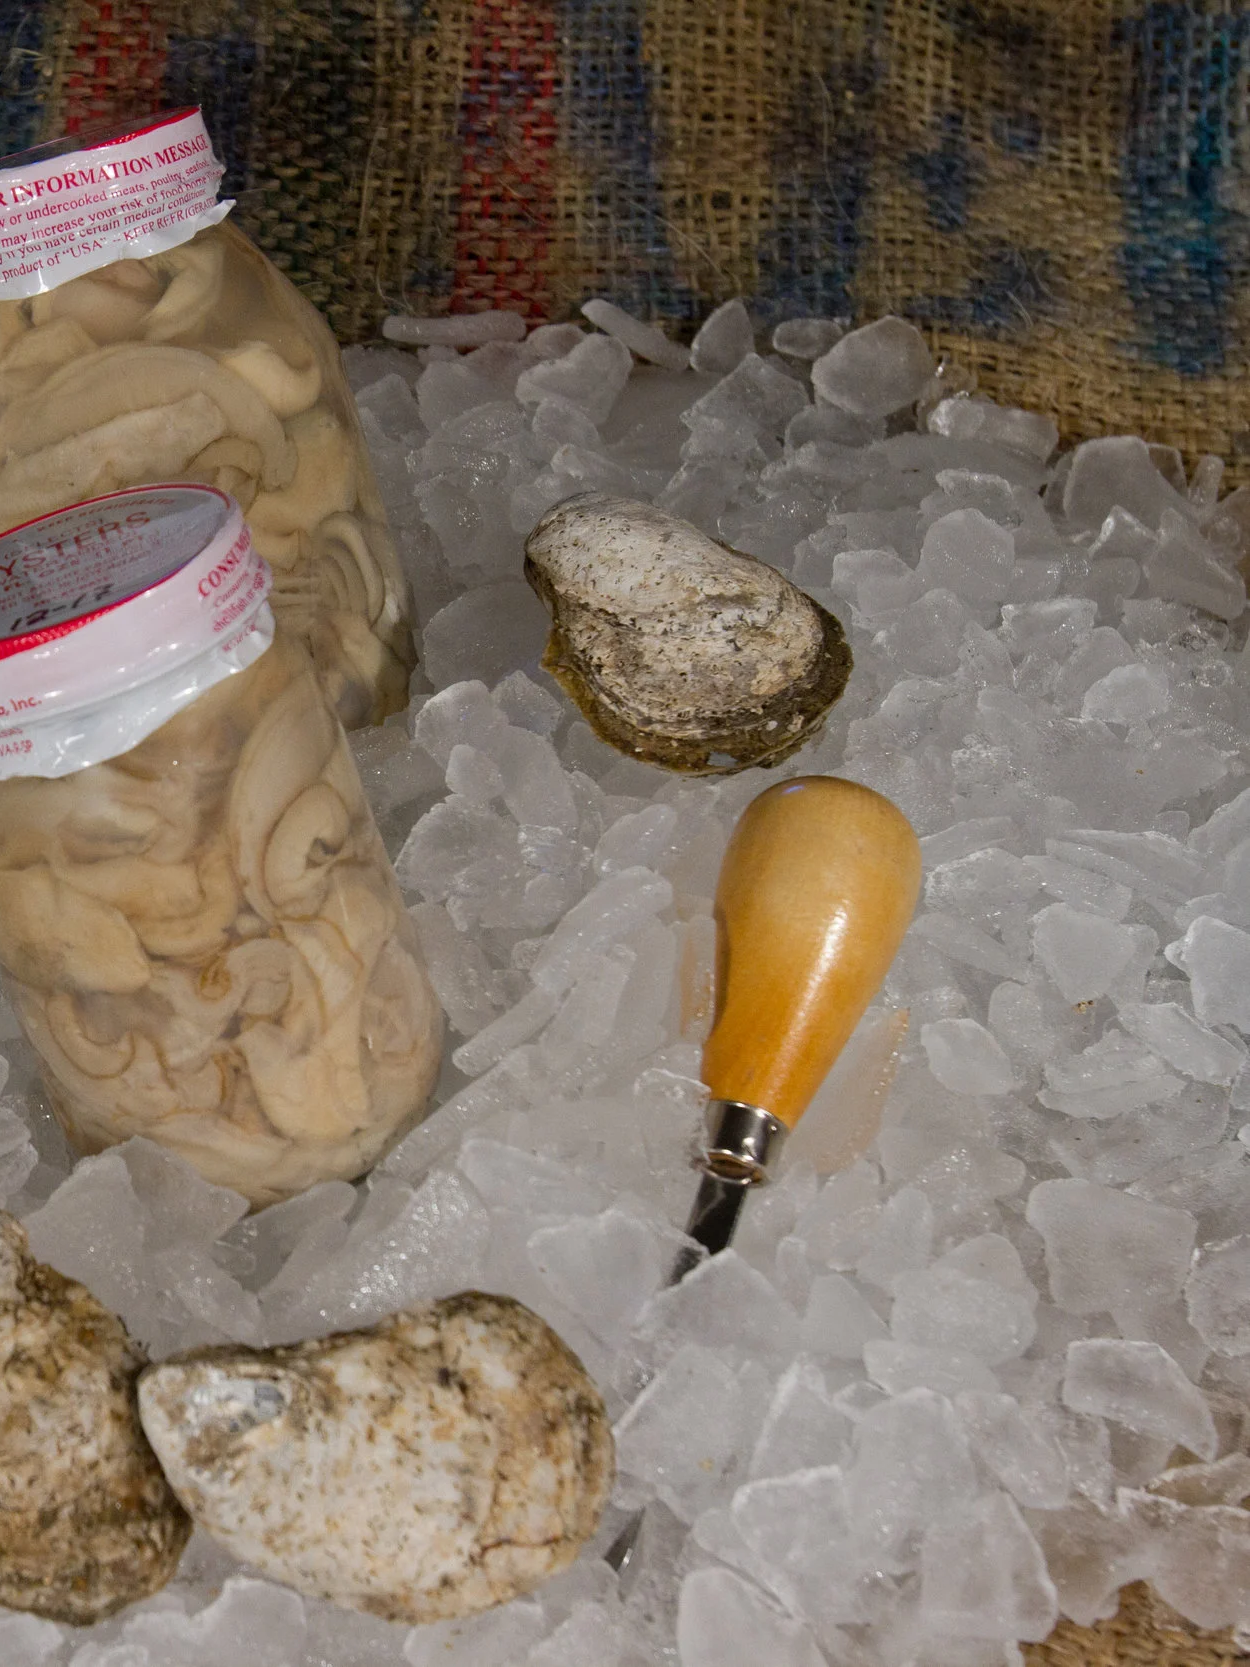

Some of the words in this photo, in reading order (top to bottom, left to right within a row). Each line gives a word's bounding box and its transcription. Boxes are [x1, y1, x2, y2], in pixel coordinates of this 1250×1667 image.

[9, 213, 22, 226] or
[26, 189, 107, 221] undercooked
[111, 183, 148, 198] meats,
[150, 170, 186, 192] poultry,
[10, 155, 153, 203] INFORMATION
[1, 233, 28, 248] may
[32, 215, 84, 240] increase
[88, 205, 117, 224] your
[120, 196, 144, 212] risk
[146, 192, 158, 205] of
[160, 183, 184, 199] food
[17, 243, 42, 259] you
[45, 233, 75, 248] have
[78, 219, 120, 239] certain
[124, 205, 165, 226] medical
[2, 260, 43, 283] product
[46, 251, 59, 267] of
[10, 696, 43, 712] Inc.
